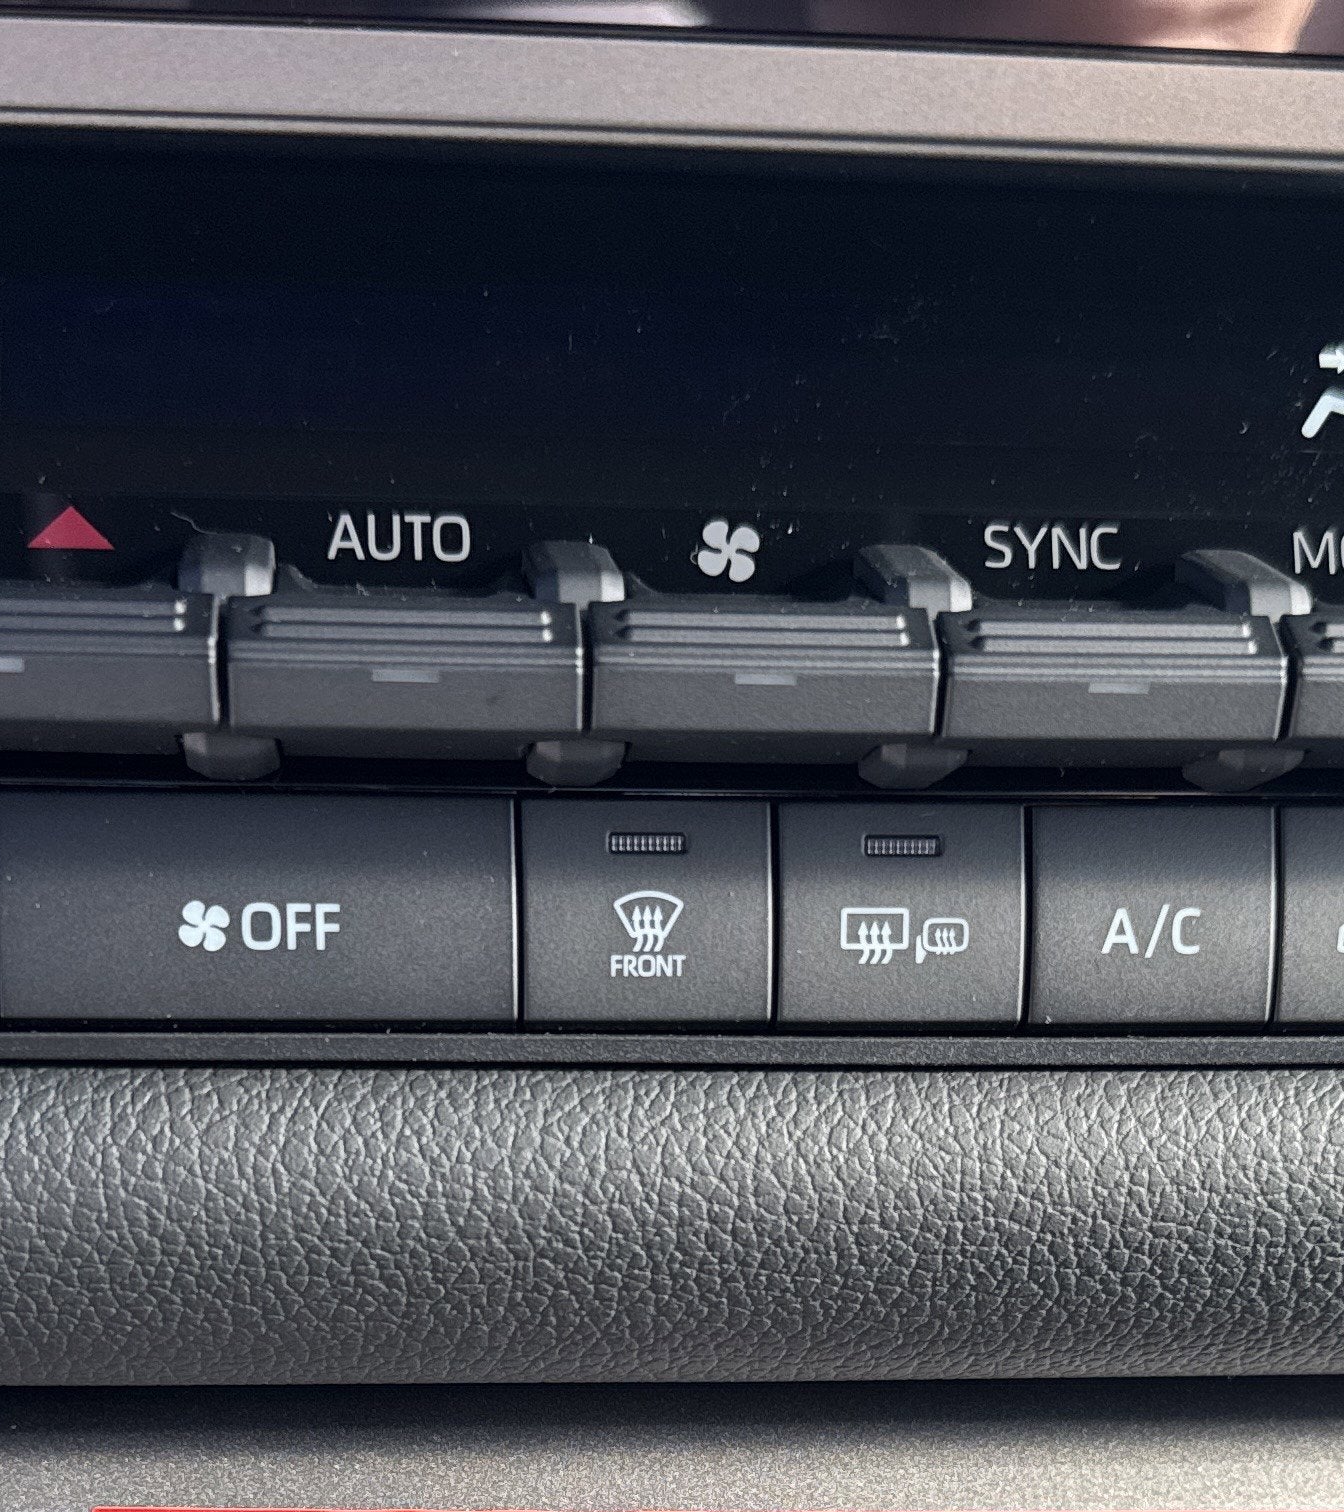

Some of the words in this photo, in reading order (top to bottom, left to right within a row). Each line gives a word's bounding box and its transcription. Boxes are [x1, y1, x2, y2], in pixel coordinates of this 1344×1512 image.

[327, 512, 471, 563] AUTO
[983, 523, 1123, 571] SYNC
[240, 901, 341, 951] OFF
[1102, 905, 1202, 959] A/C
[610, 953, 686, 978] FRONT
